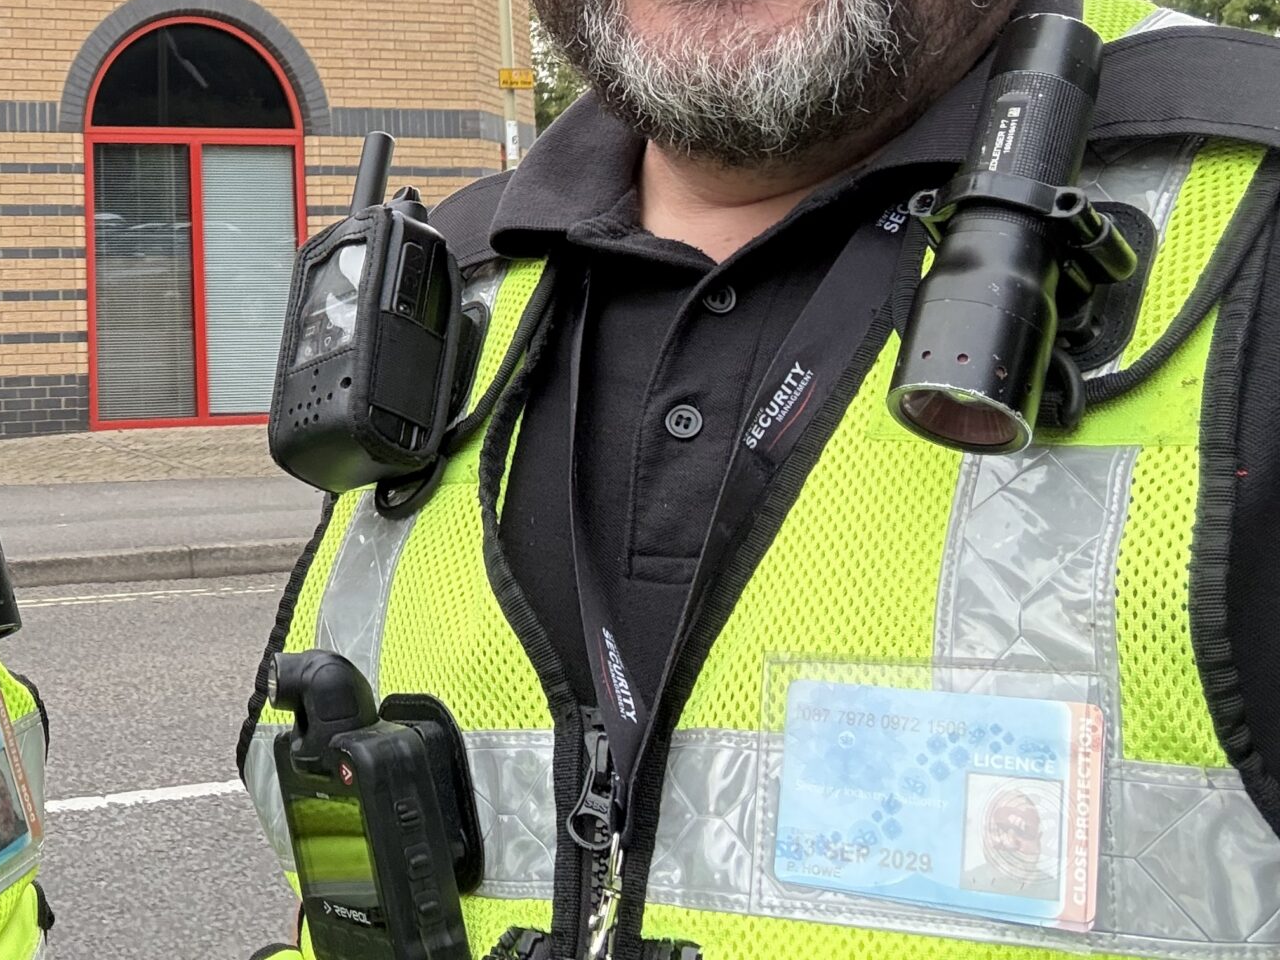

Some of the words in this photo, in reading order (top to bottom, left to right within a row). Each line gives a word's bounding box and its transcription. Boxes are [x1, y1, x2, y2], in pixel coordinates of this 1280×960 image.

[745, 361, 806, 449] SECURITY
[776, 369, 815, 423] MANAGEMENT
[602, 626, 638, 724] SECURITY
[607, 660, 627, 720] MANAGEMENT
[973, 751, 1056, 775] LICENCE
[1074, 717, 1093, 840] PROTECTION
[801, 863, 842, 879] HOWE
[878, 848, 934, 873] 2029
[1073, 847, 1088, 906] CLOSE
